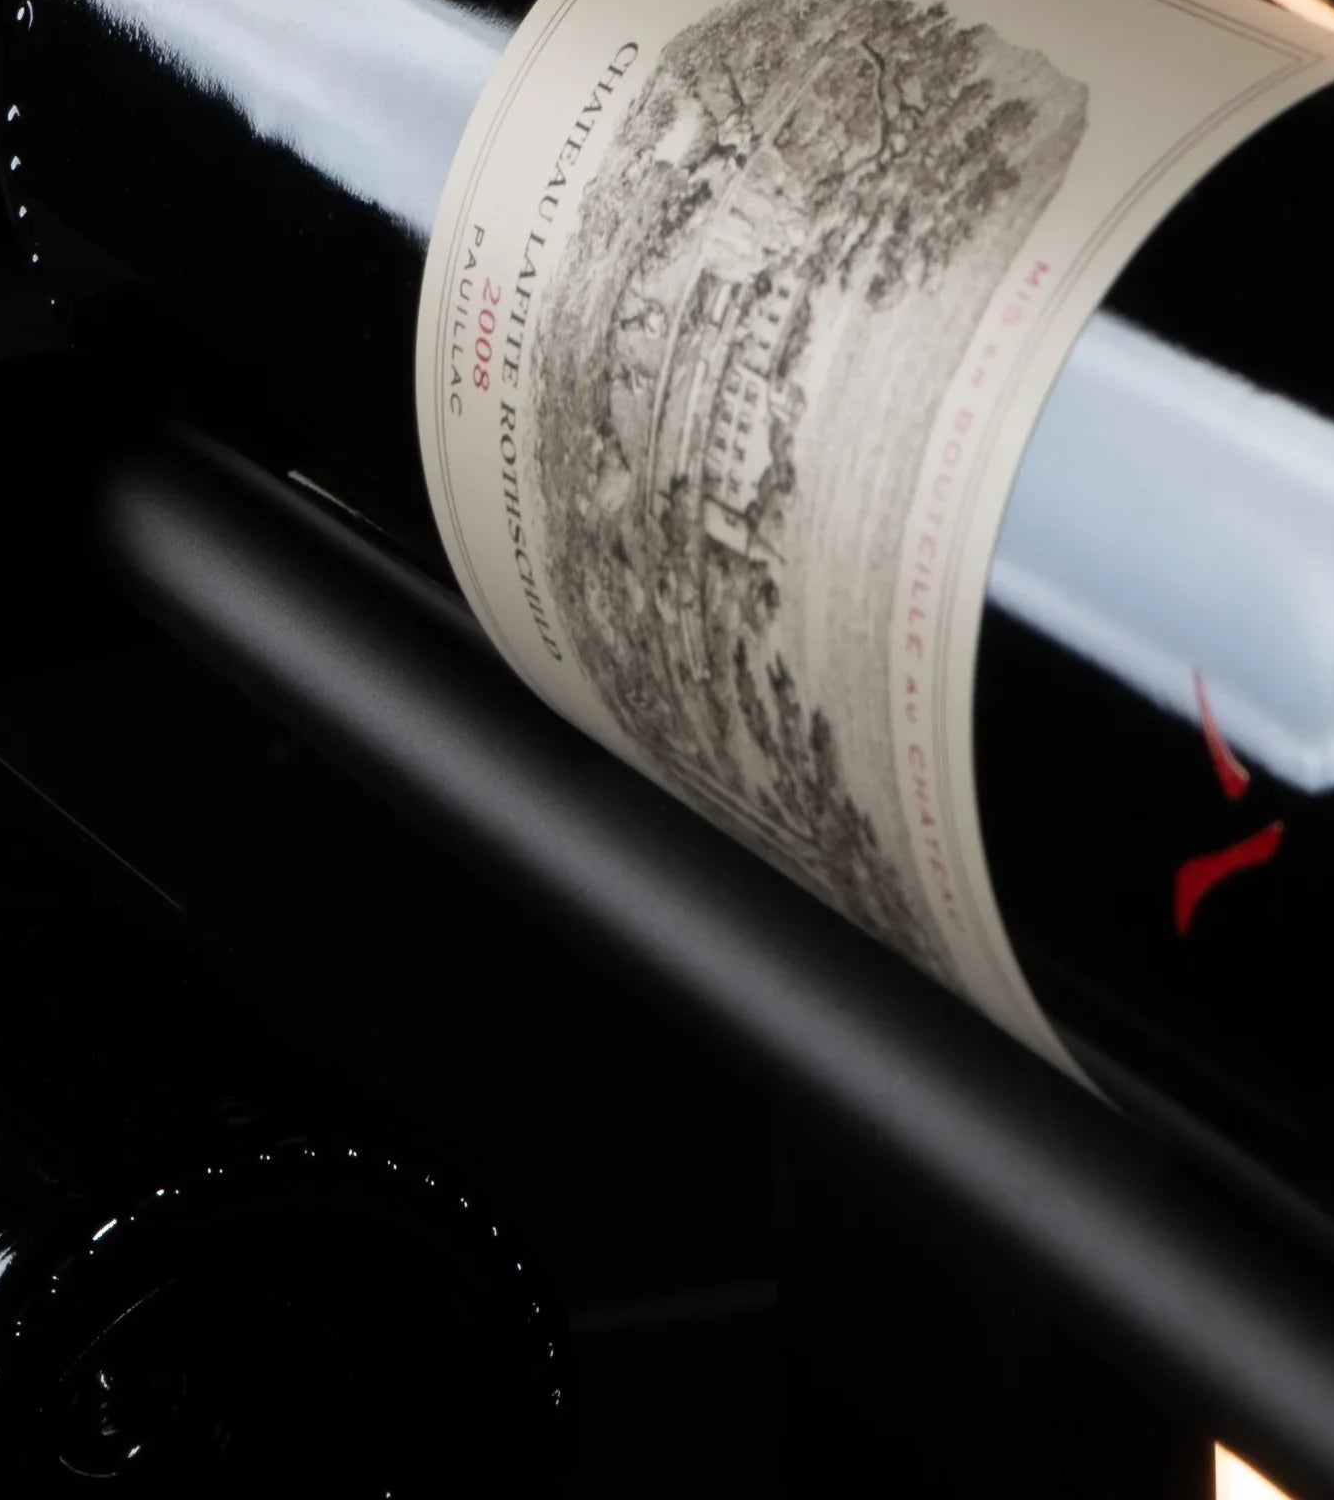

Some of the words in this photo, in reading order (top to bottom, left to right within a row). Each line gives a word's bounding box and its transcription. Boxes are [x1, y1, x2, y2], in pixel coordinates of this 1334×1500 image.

[537, 40, 640, 224] CHATEAU
[449, 223, 486, 417] PAUILLAC
[471, 276, 502, 392] 2008
[501, 228, 547, 389] LAFITE
[499, 399, 563, 663] ROTHSCHILD
